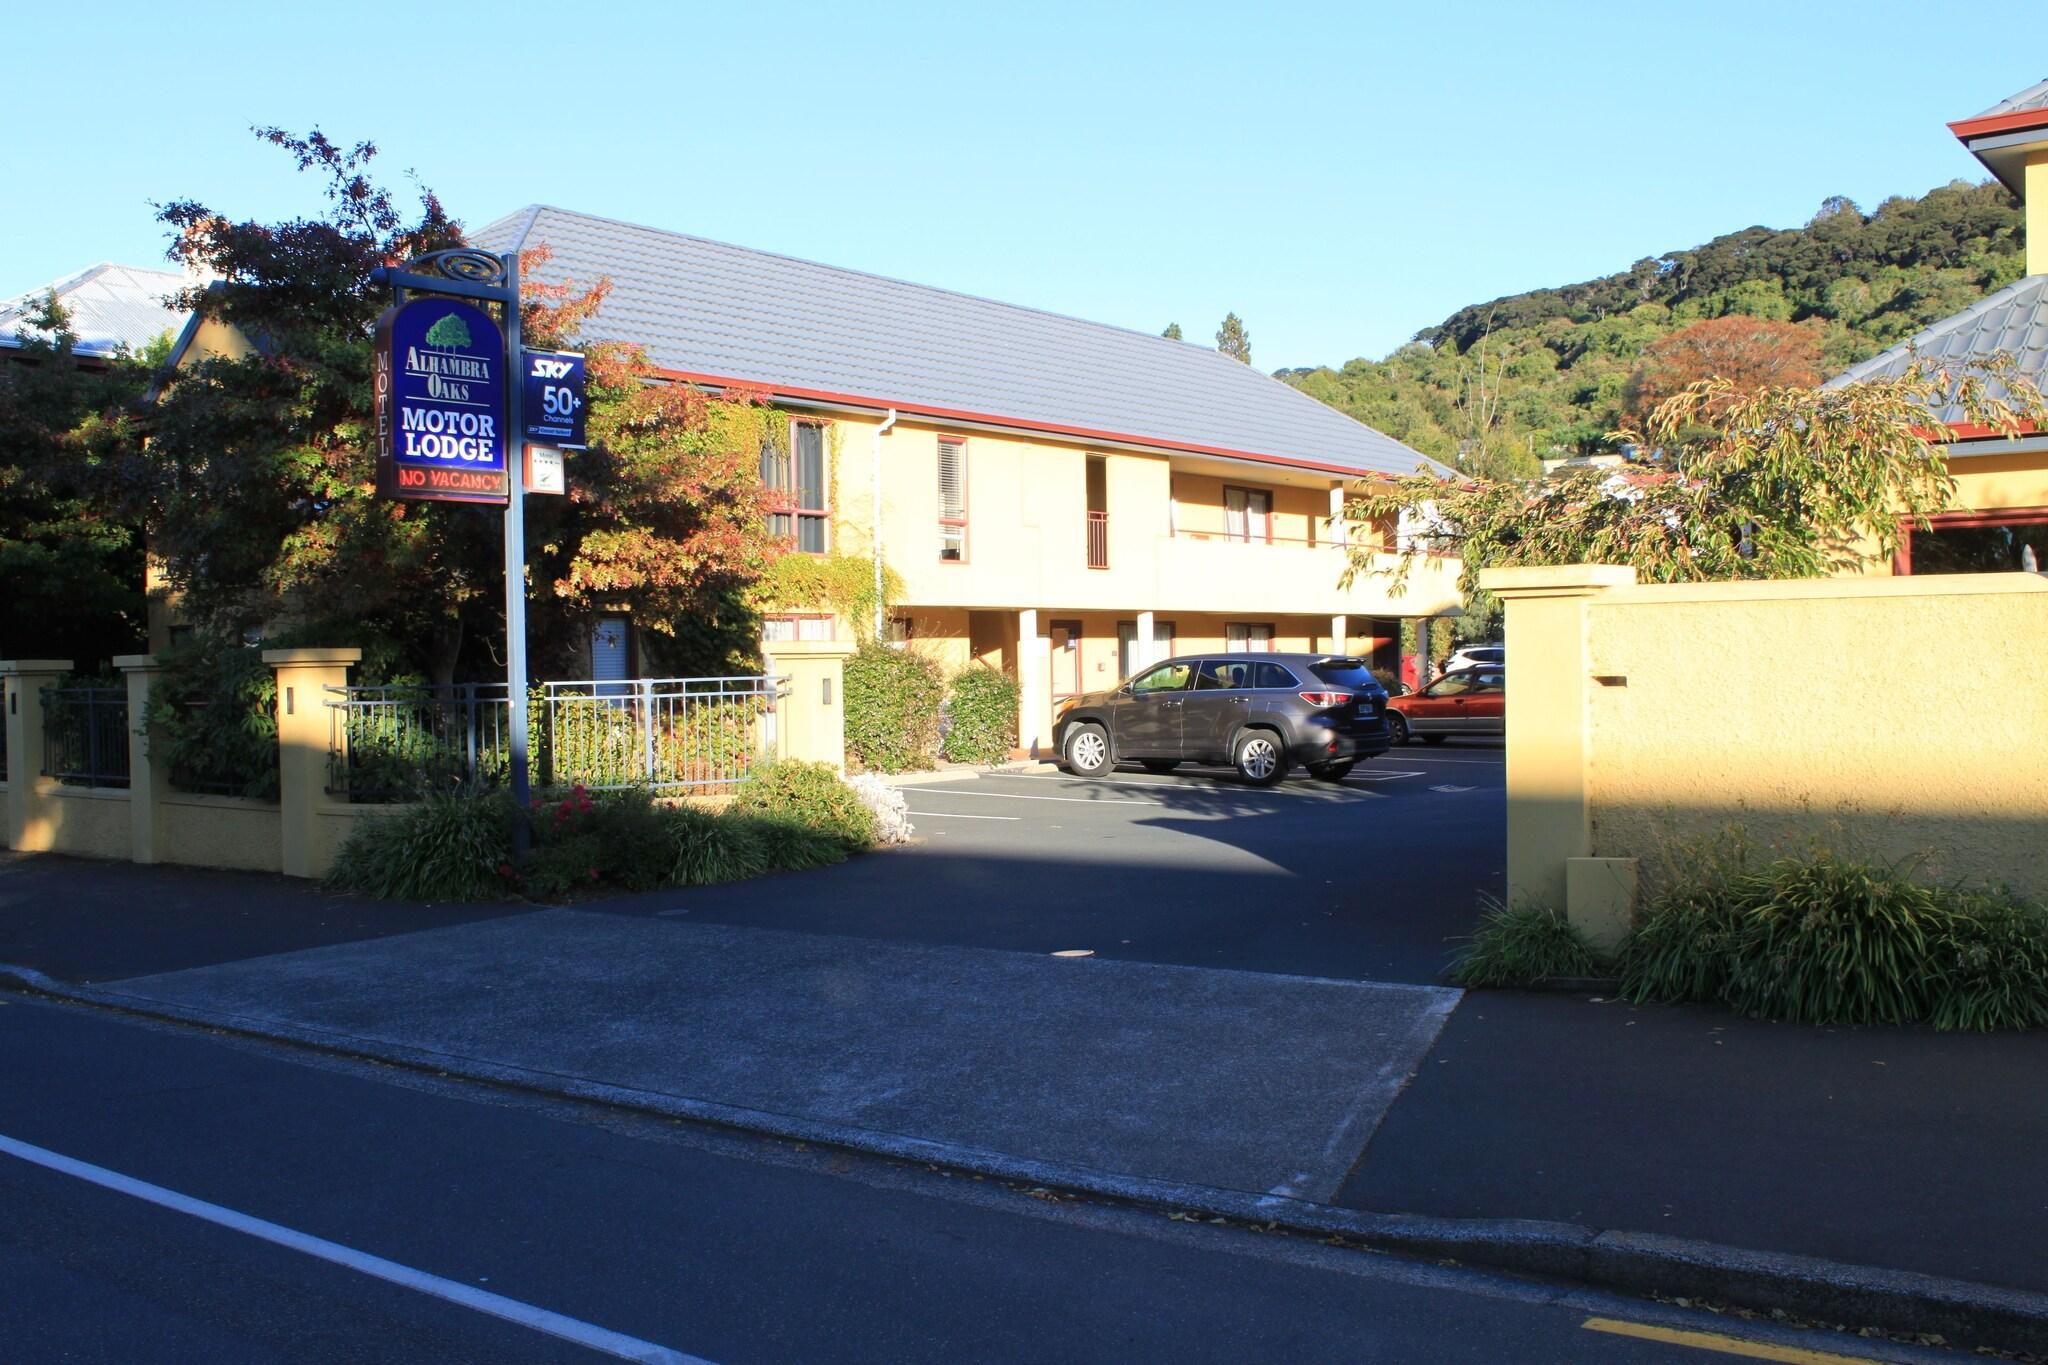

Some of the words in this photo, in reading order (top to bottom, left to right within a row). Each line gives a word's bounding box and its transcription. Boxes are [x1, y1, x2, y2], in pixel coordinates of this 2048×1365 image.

[405, 346, 490, 379] ALHAMBRA
[531, 359, 574, 379] SKY
[427, 373, 469, 401] OAKS
[377, 351, 389, 457] MOTEL
[402, 407, 496, 438] MOTOR
[543, 414, 574, 425] Channels
[405, 432, 494, 462] LODGE
[401, 469, 425, 486] NO
[430, 470, 501, 490] VACANCY
